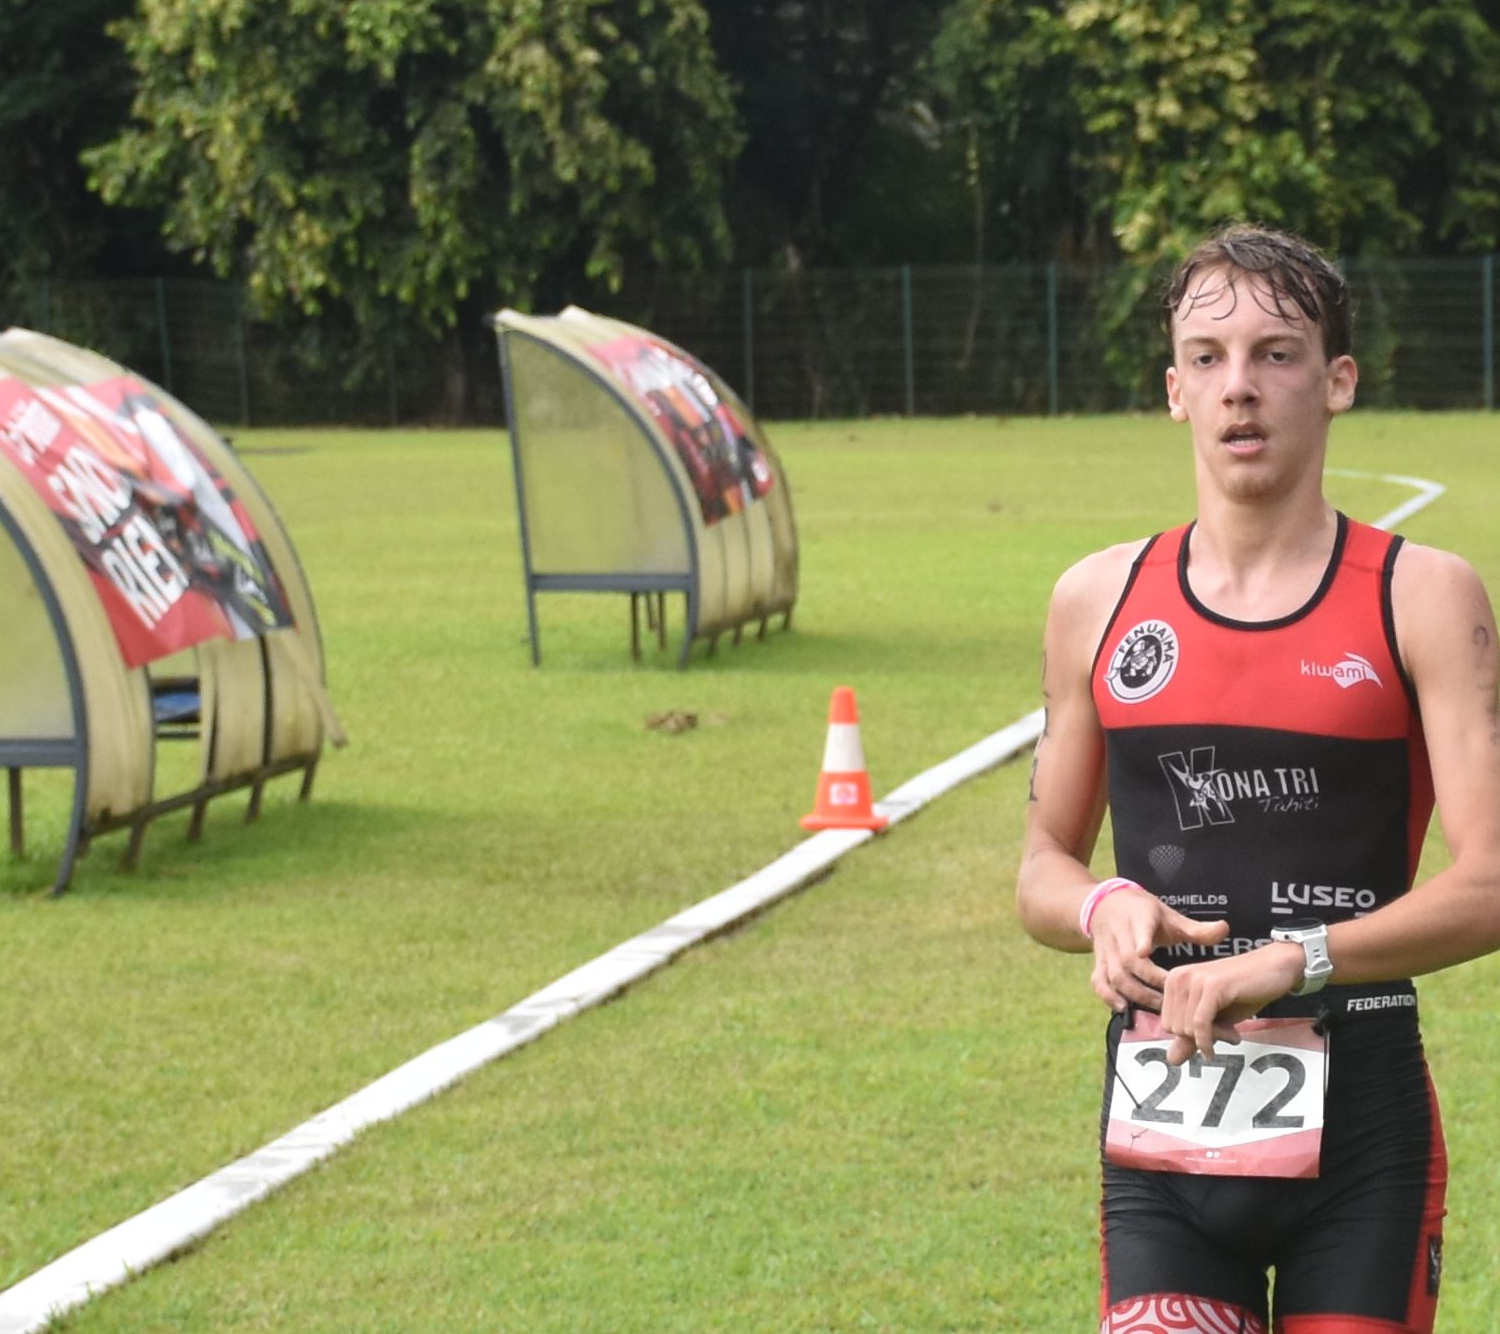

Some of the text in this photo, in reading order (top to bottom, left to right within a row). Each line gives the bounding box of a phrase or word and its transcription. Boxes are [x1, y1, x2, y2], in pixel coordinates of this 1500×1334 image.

[1300, 658, 1367, 681] kiwami
[1274, 767, 1320, 795] TRI
[1258, 796, 1320, 813] Tahiti
[1156, 893, 1229, 906] OSHIELDS
[1271, 881, 1376, 907] LUSEO
[1130, 1046, 1307, 1129] 272
